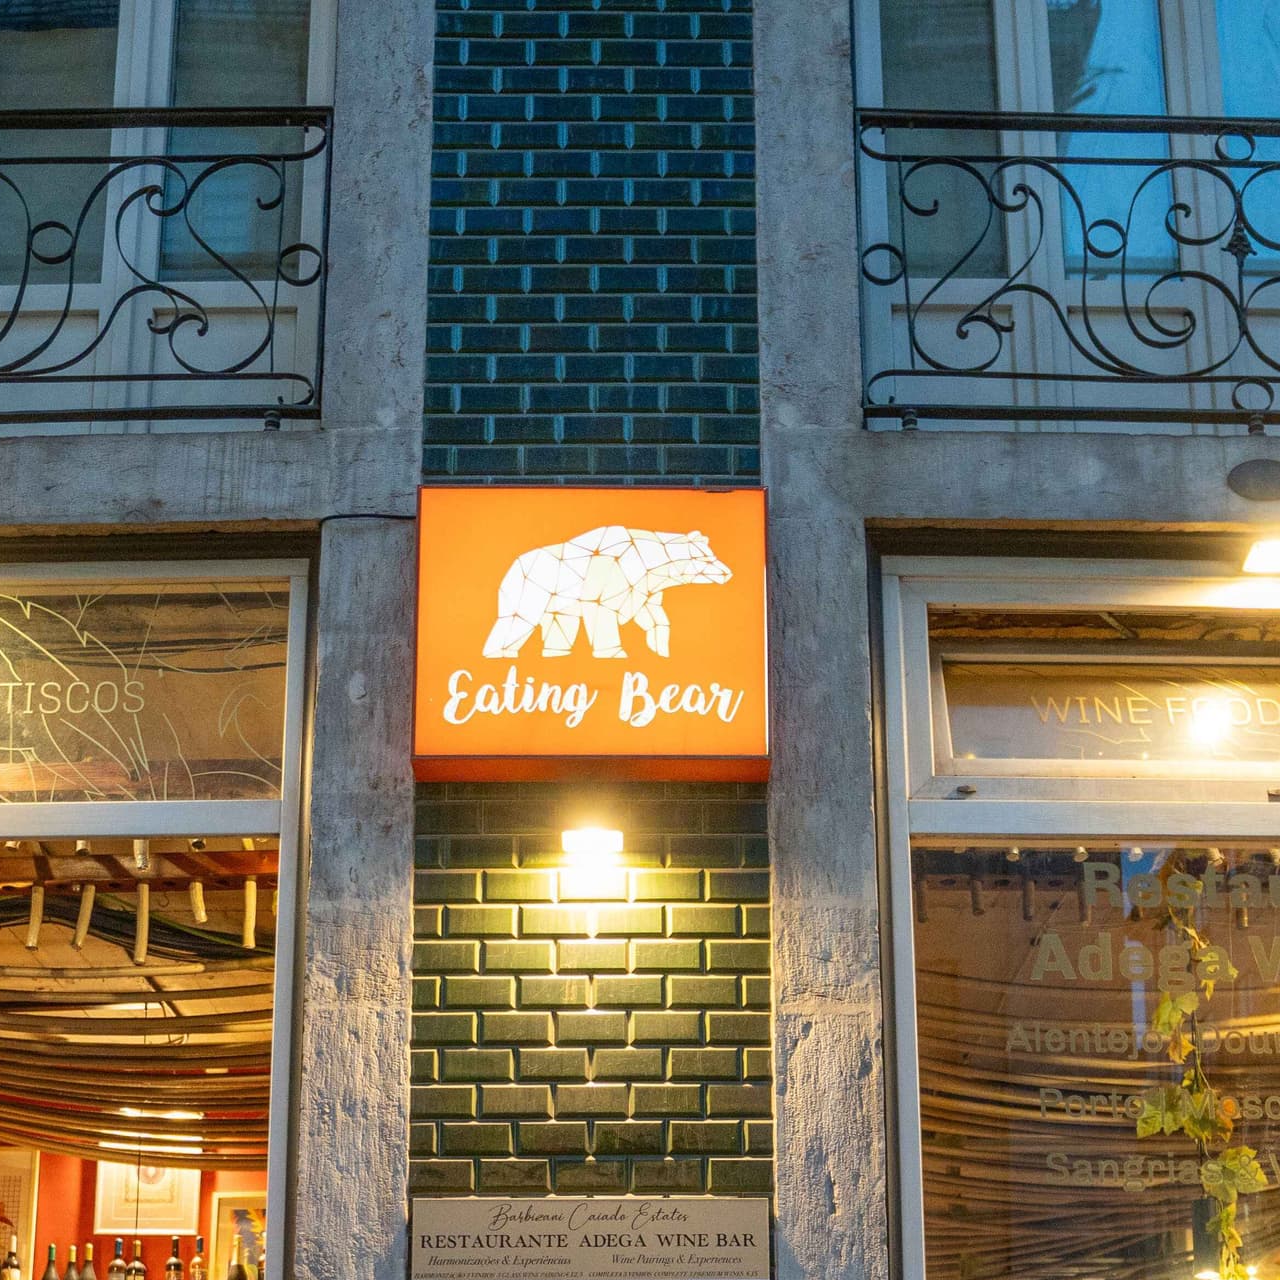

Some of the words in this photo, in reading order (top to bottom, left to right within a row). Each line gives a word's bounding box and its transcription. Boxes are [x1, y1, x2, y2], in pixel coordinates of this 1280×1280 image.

[442, 665, 598, 728] Eating
[619, 671, 744, 727] Bear
[1031, 696, 1153, 724] WINE
[1031, 932, 1230, 993] Adega
[1006, 1023, 1165, 1059] Alentejo
[1039, 1087, 1147, 1121] Porto
[631, 1201, 688, 1231] Estates
[420, 1234, 568, 1249] RESTAURANTE
[579, 1234, 647, 1248] ADEGA
[657, 1233, 709, 1247] WINE
[716, 1233, 757, 1247] BAR
[611, 1254, 635, 1264] Wine
[636, 1253, 674, 1267] Pairings
[676, 1254, 686, 1264] &
